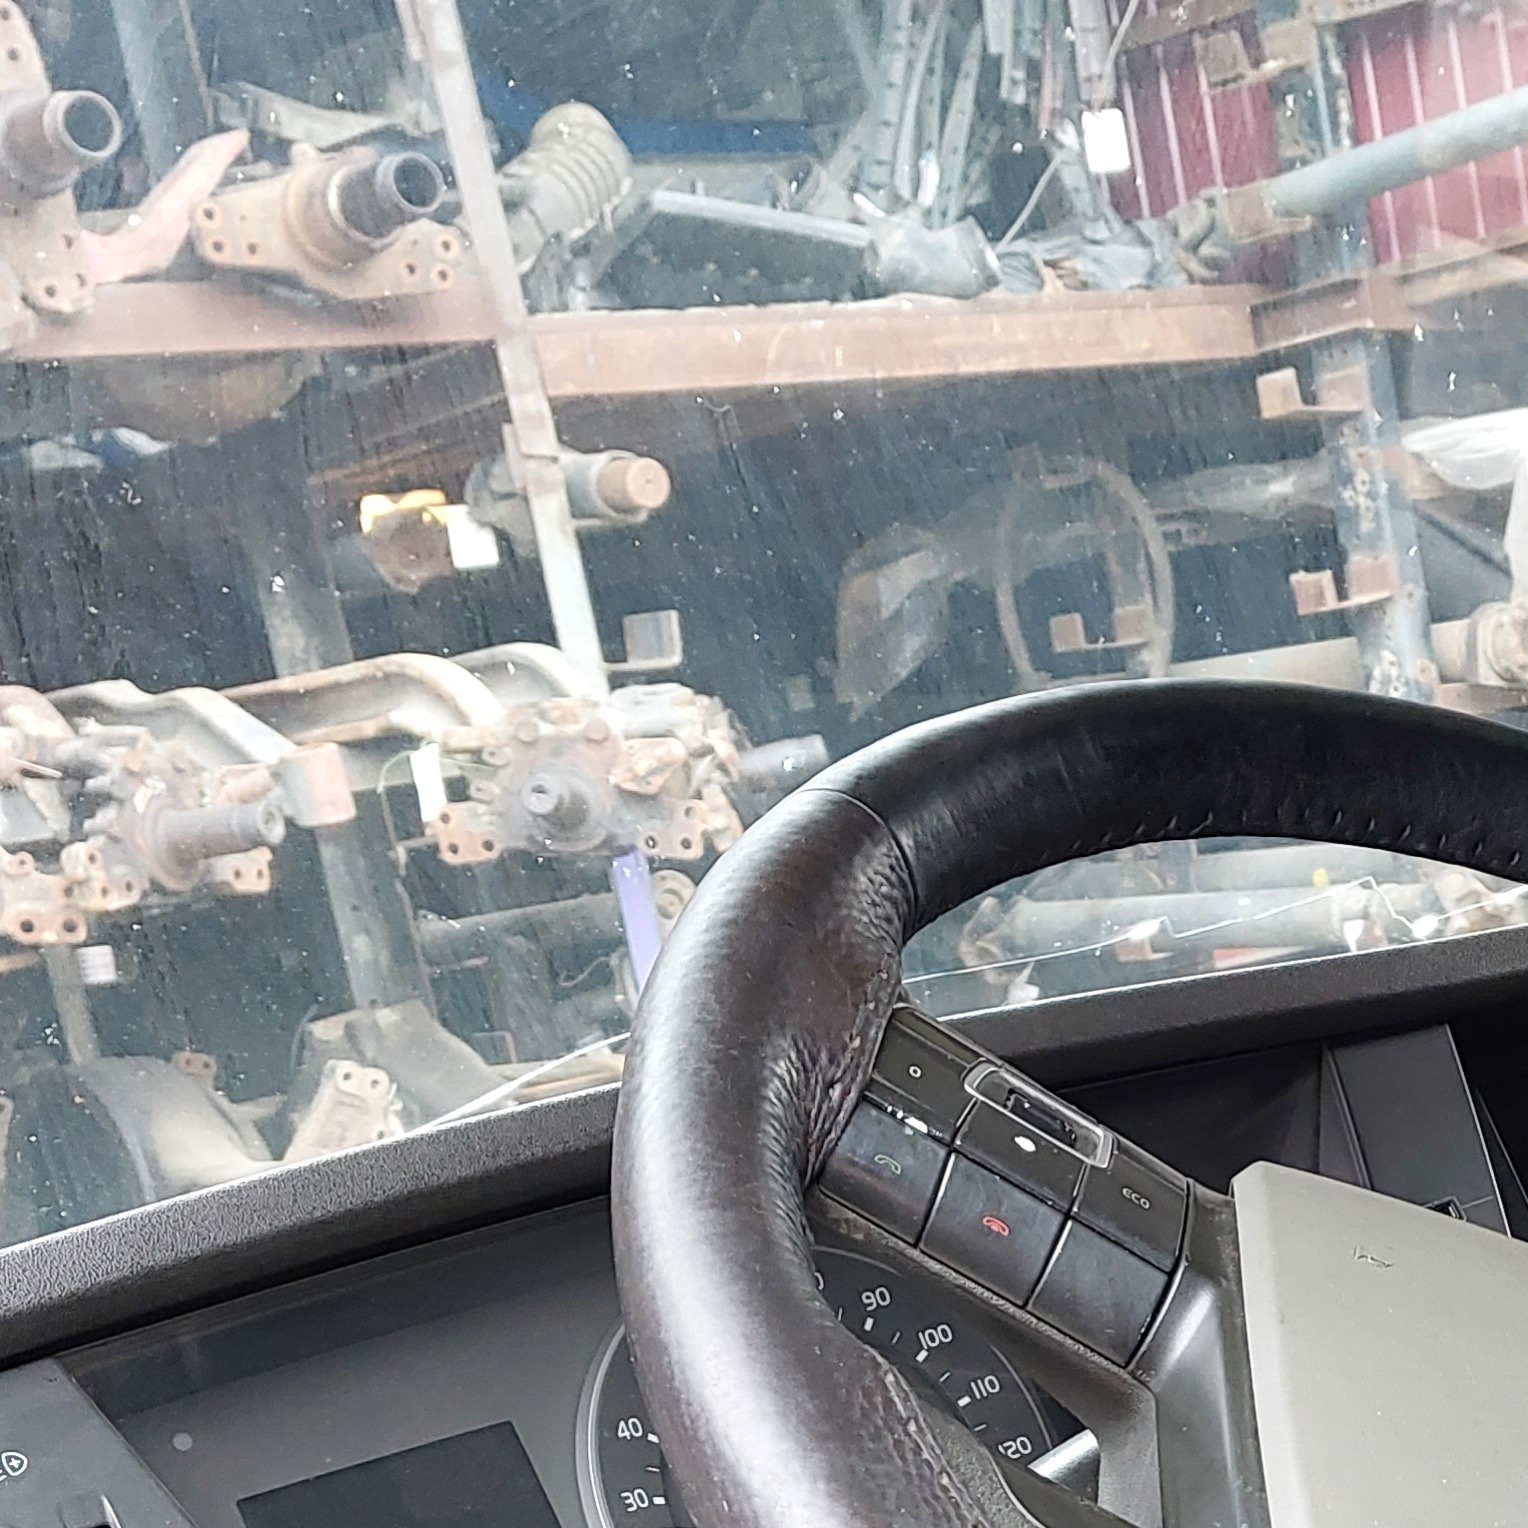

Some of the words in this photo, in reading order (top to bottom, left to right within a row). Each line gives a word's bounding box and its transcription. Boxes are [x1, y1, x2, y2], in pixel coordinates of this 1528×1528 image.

[1122, 1187, 1151, 1209] ECO
[861, 1286, 891, 1311] 90
[918, 1324, 953, 1349] 100
[970, 1374, 1001, 1400] 110
[617, 1417, 644, 1441] 40
[620, 1488, 649, 1512] 30
